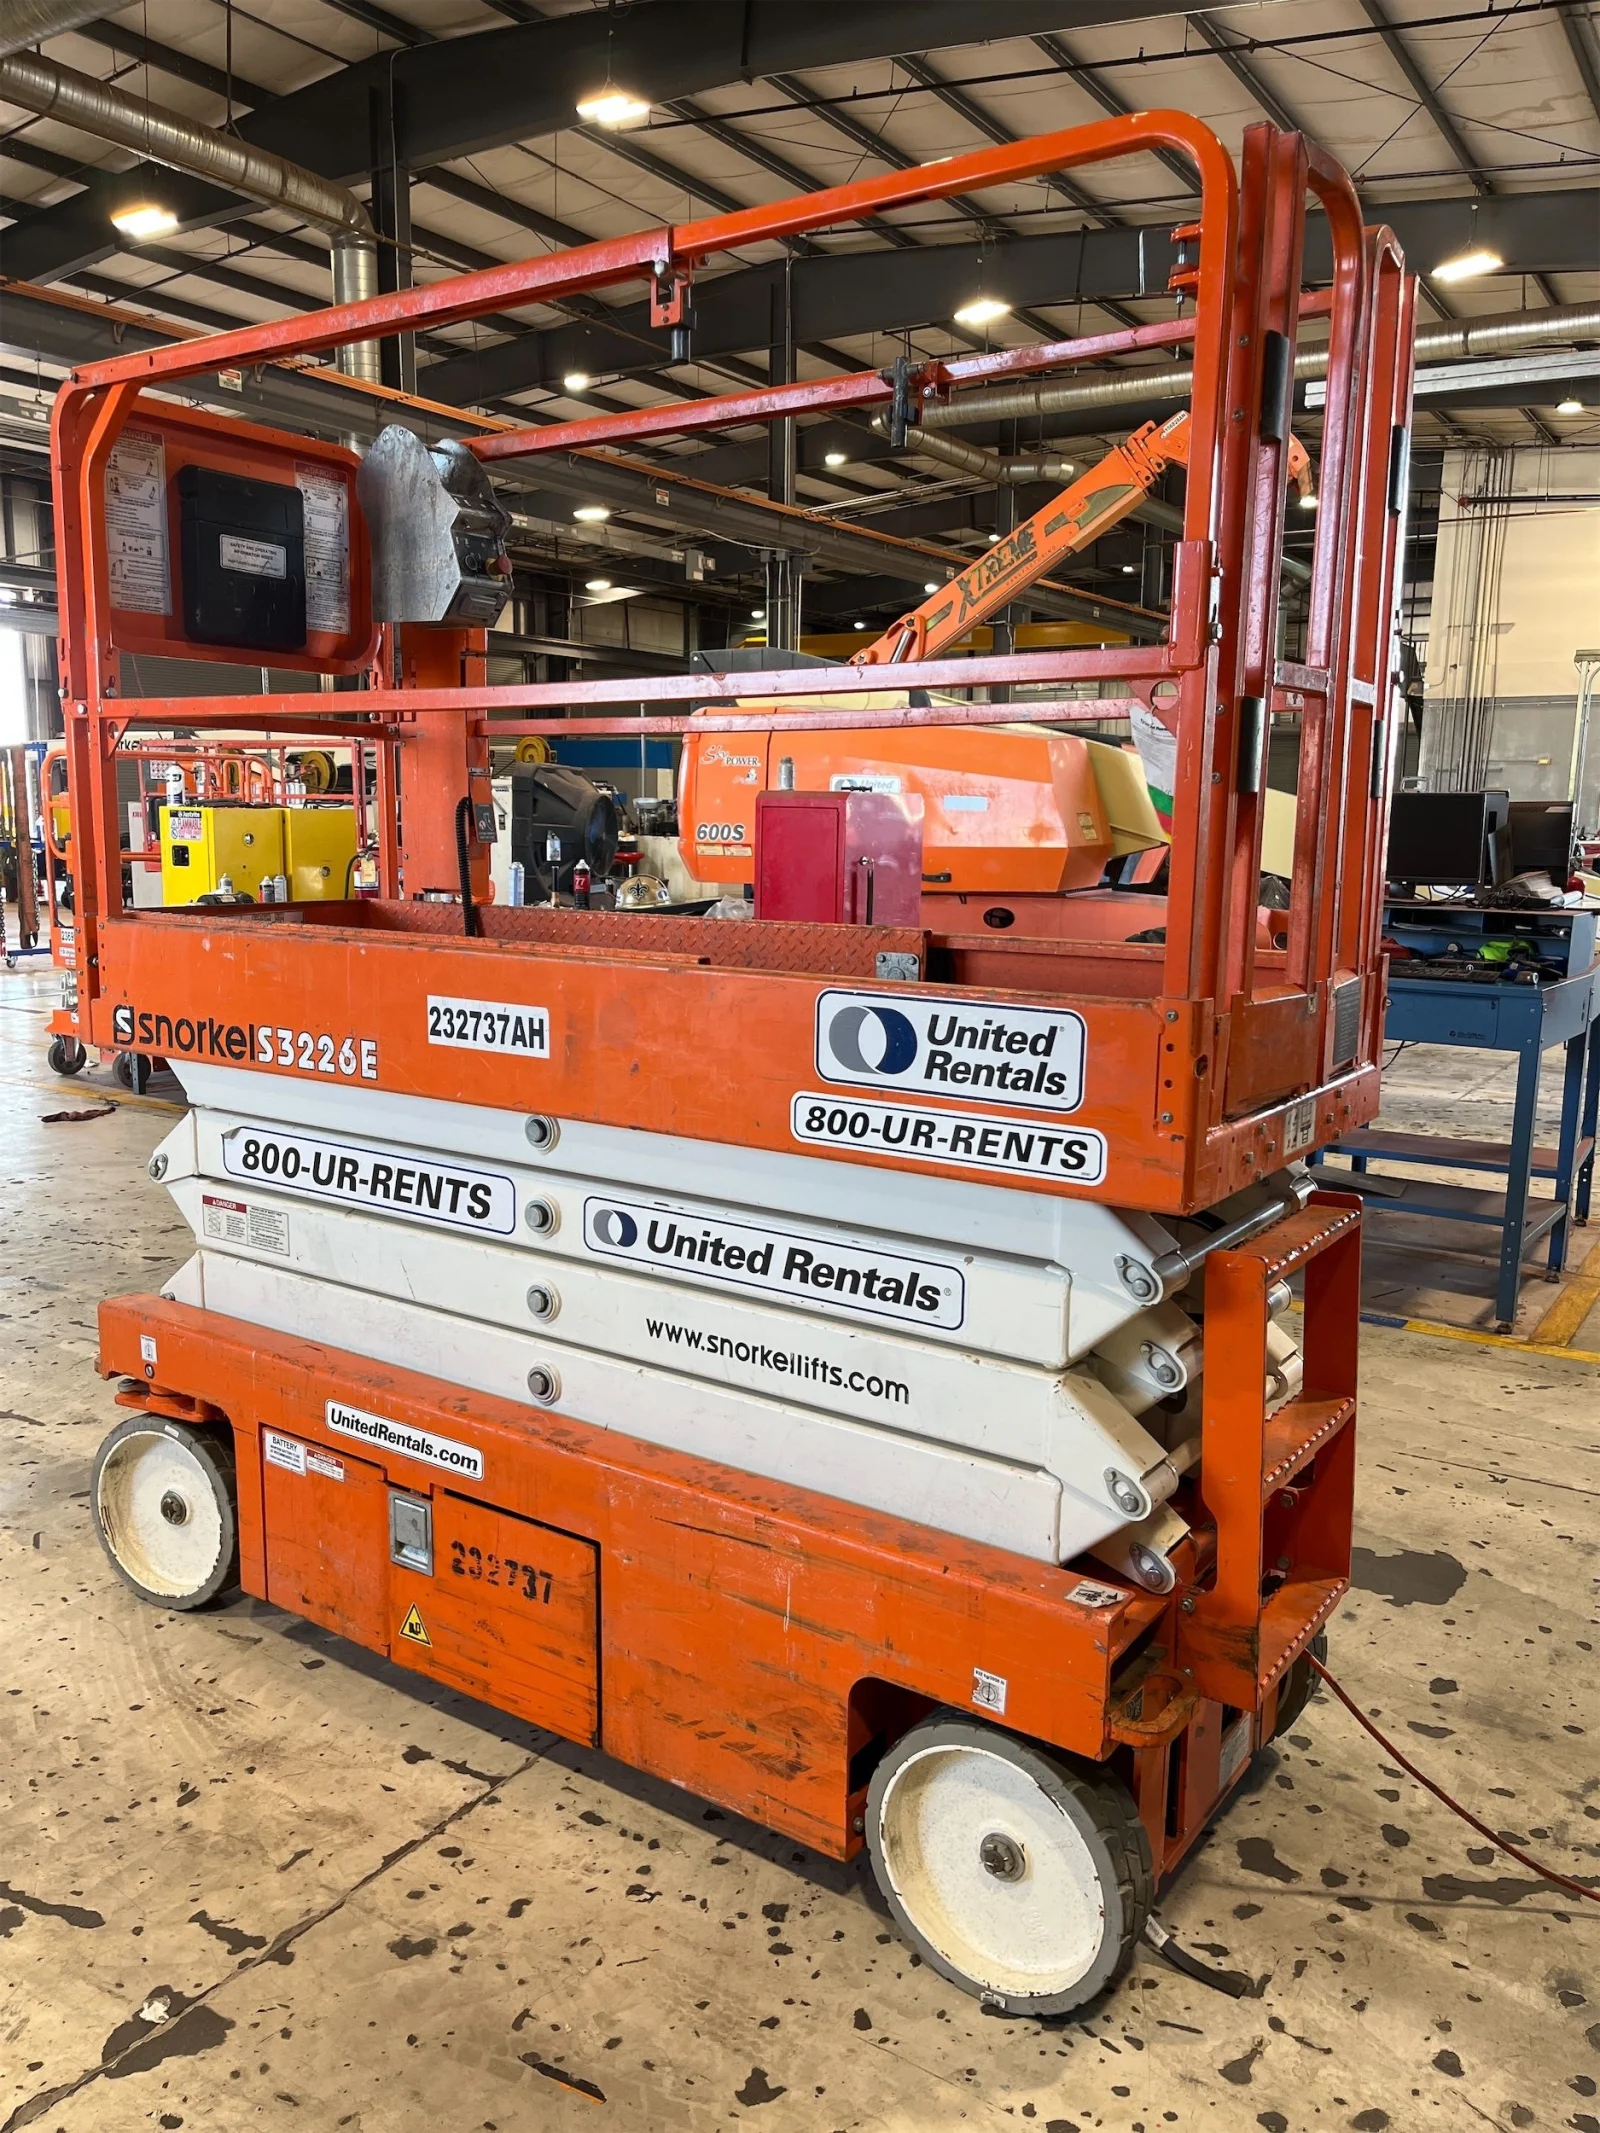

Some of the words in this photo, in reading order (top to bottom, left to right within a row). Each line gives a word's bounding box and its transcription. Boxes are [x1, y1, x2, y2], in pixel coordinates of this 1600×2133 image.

[234, 549, 260, 559] INFORMATION
[726, 757, 758, 766] POWER
[696, 823, 745, 842] 600S
[575, 877, 586, 887] 77
[138, 1012, 255, 1062] snorkel
[256, 1025, 379, 1081] S3226E
[429, 1006, 545, 1050] 232737AH
[927, 1013, 1059, 1058] United
[923, 1049, 1068, 1096] Rentals
[805, 1105, 1089, 1171] 800-UR-RENTS
[241, 1138, 492, 1220] 800-UR-RENTS
[216, 1200, 237, 1210] DANGER
[646, 1219, 775, 1277] United
[781, 1247, 942, 1313] Rentals
[645, 1317, 910, 1405] www.snorkellifts.com
[272, 1436, 298, 1452] BATTERY
[317, 1453, 337, 1466] DANGER
[330, 1407, 478, 1472] UnitedRentals.com
